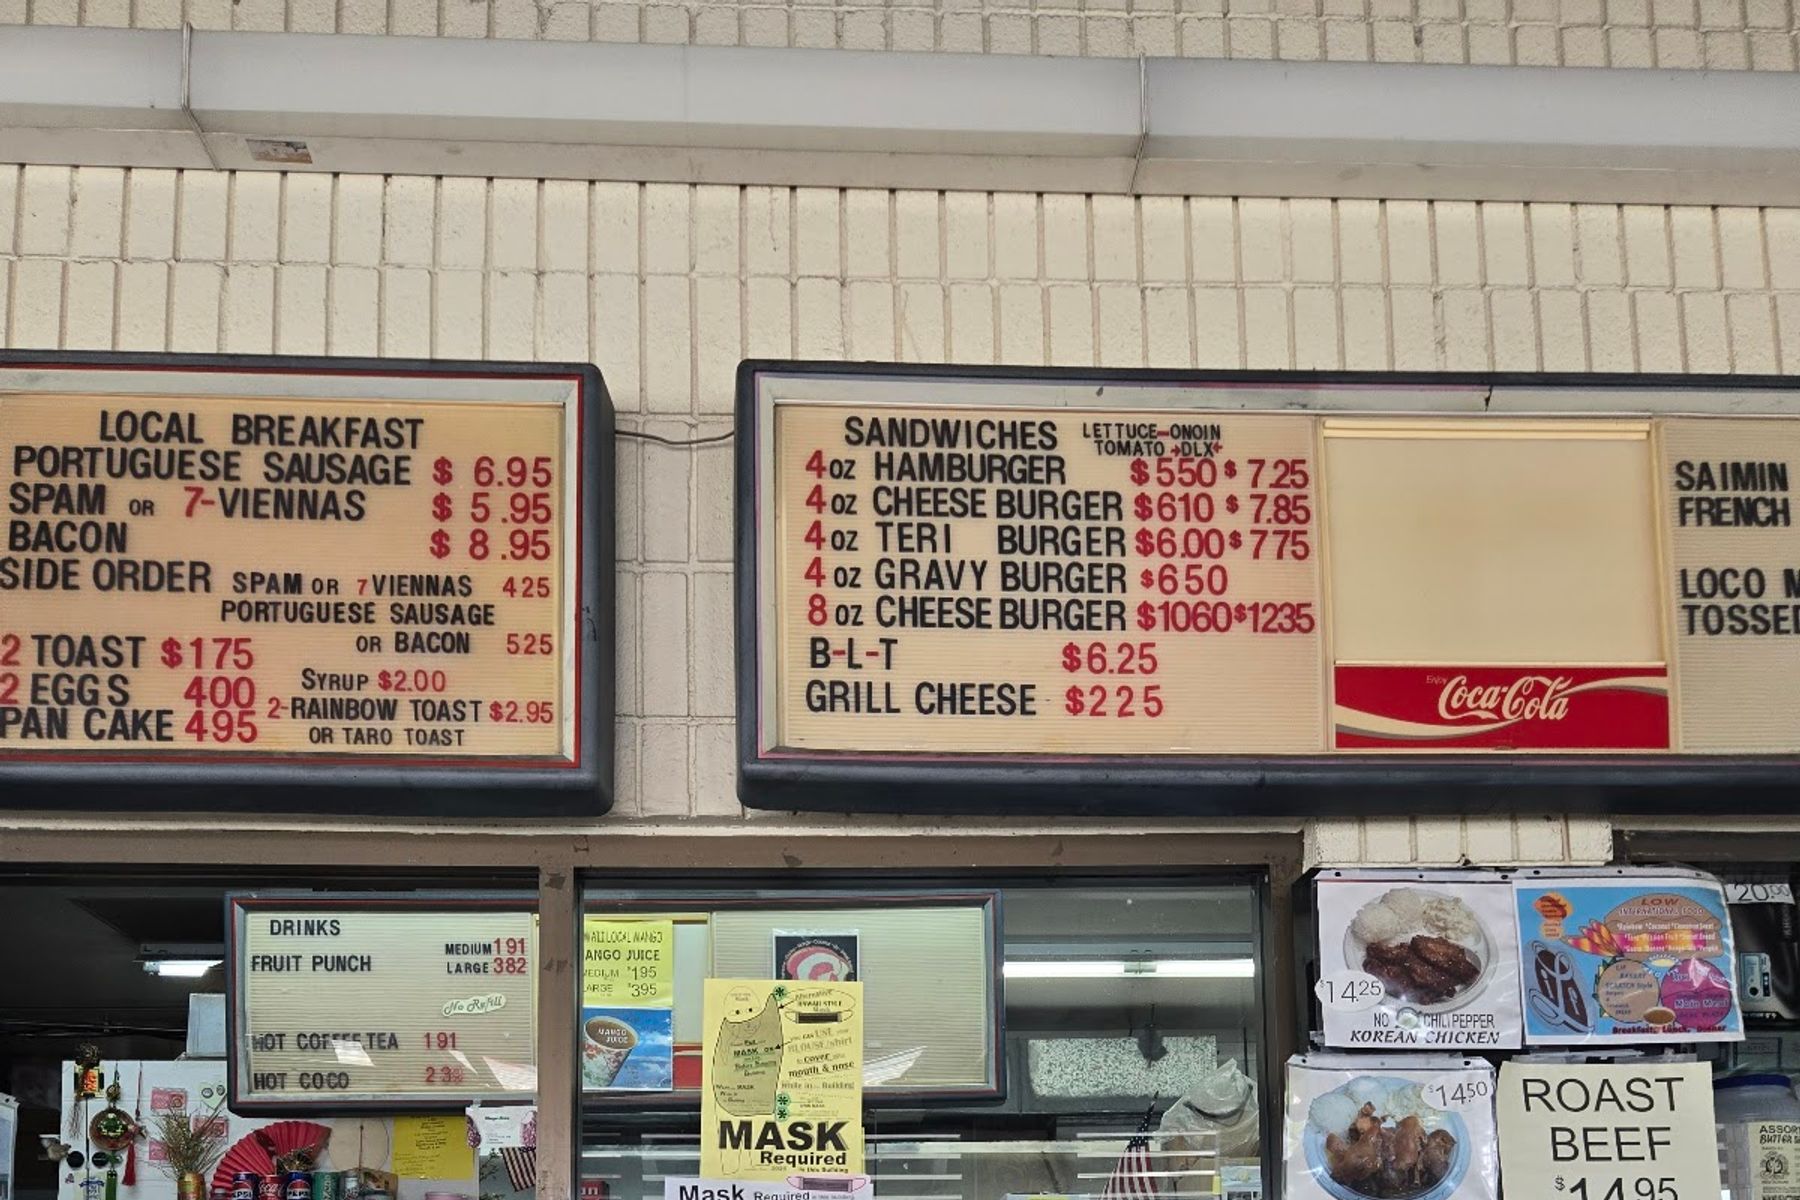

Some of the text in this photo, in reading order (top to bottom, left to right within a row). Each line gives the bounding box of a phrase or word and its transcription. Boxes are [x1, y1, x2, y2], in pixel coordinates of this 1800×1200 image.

[99, 410, 424, 449] LOCAL BREAKFAST
[844, 415, 1058, 450] SANDWICHES
[1094, 439, 1164, 457] TOMATO
[14, 446, 412, 486] PORTUGUESE SAUSAGE
[805, 450, 1066, 485] 4 HAMBURGER
[1675, 461, 1789, 492] SAIMIN
[10, 483, 107, 516] SPAM
[129, 499, 154, 516] OR
[805, 486, 1123, 522] 4 CHEESE BURGER
[1679, 496, 1790, 527] FRENCH
[10, 521, 127, 553] BACON
[875, 523, 951, 554] TERI
[998, 524, 1126, 558] BURGER
[0, 559, 211, 594] SIDE ORDER
[232, 572, 338, 595] SPAM OR
[874, 560, 1127, 594] GRAVY BURGER
[1680, 568, 1766, 600] LOCO
[221, 601, 494, 625] PORTUGUESE SAUSAGE
[807, 596, 1127, 631] 8 CHEESE BURGER
[32, 634, 146, 668] TOAST
[356, 632, 552, 655] OR BACON 525
[1062, 642, 1158, 674] $6.25
[31, 674, 255, 708] EGGS 400
[378, 670, 446, 692] $2.00
[412, 700, 553, 724] TOAST $2.95
[806, 680, 1036, 716] GRILL CHEESE
[84, 709, 257, 743] CAKE 495
[344, 728, 464, 747] TARO TOAST
[270, 920, 341, 936] DRINKS
[445, 938, 526, 956] MEDIUM 191
[626, 950, 660, 961] JUICE
[252, 956, 372, 972] FRUIT PUNCH
[446, 957, 526, 974] LARGE 382
[1374, 1013, 1495, 1028] NO PEPPER
[252, 1033, 286, 1050] HOT
[1350, 1030, 1500, 1044] KOREAN CHICKEN
[254, 1072, 350, 1090] HOT COCO
[1522, 1075, 1684, 1113] ROAST
[719, 1121, 849, 1151] MASK
[1551, 1126, 1672, 1162] BEEF
[760, 1151, 846, 1169] Required
